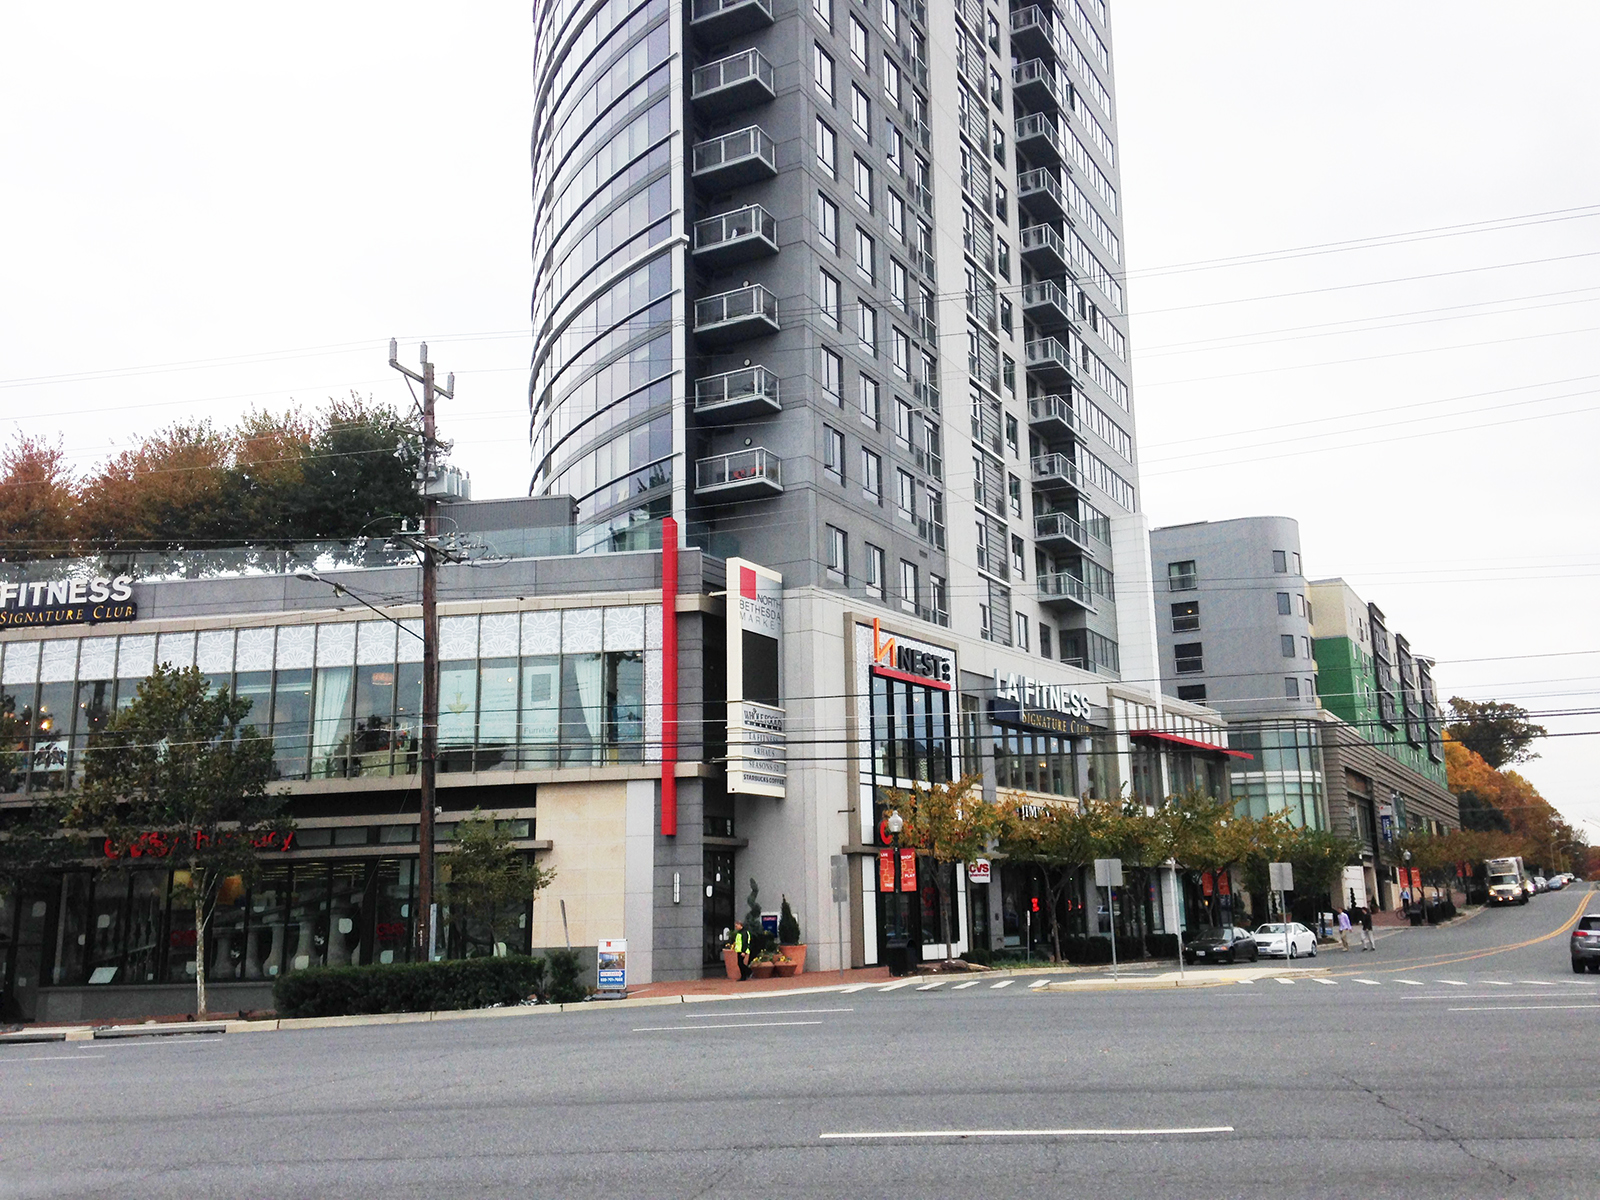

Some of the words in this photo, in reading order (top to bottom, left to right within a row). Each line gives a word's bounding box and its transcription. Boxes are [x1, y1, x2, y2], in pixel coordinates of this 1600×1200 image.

[0, 576, 133, 608] FITNESS
[757, 594, 781, 610] NORTH
[0, 609, 83, 624] SIGNATURE
[93, 605, 133, 620] CLUB
[740, 599, 782, 622] BETHESDA
[898, 645, 942, 679] NEST
[993, 668, 1020, 703] LA
[1022, 676, 1092, 720] FITNESS
[1022, 709, 1067, 733] SIGNATURE
[969, 863, 989, 873] CVS
